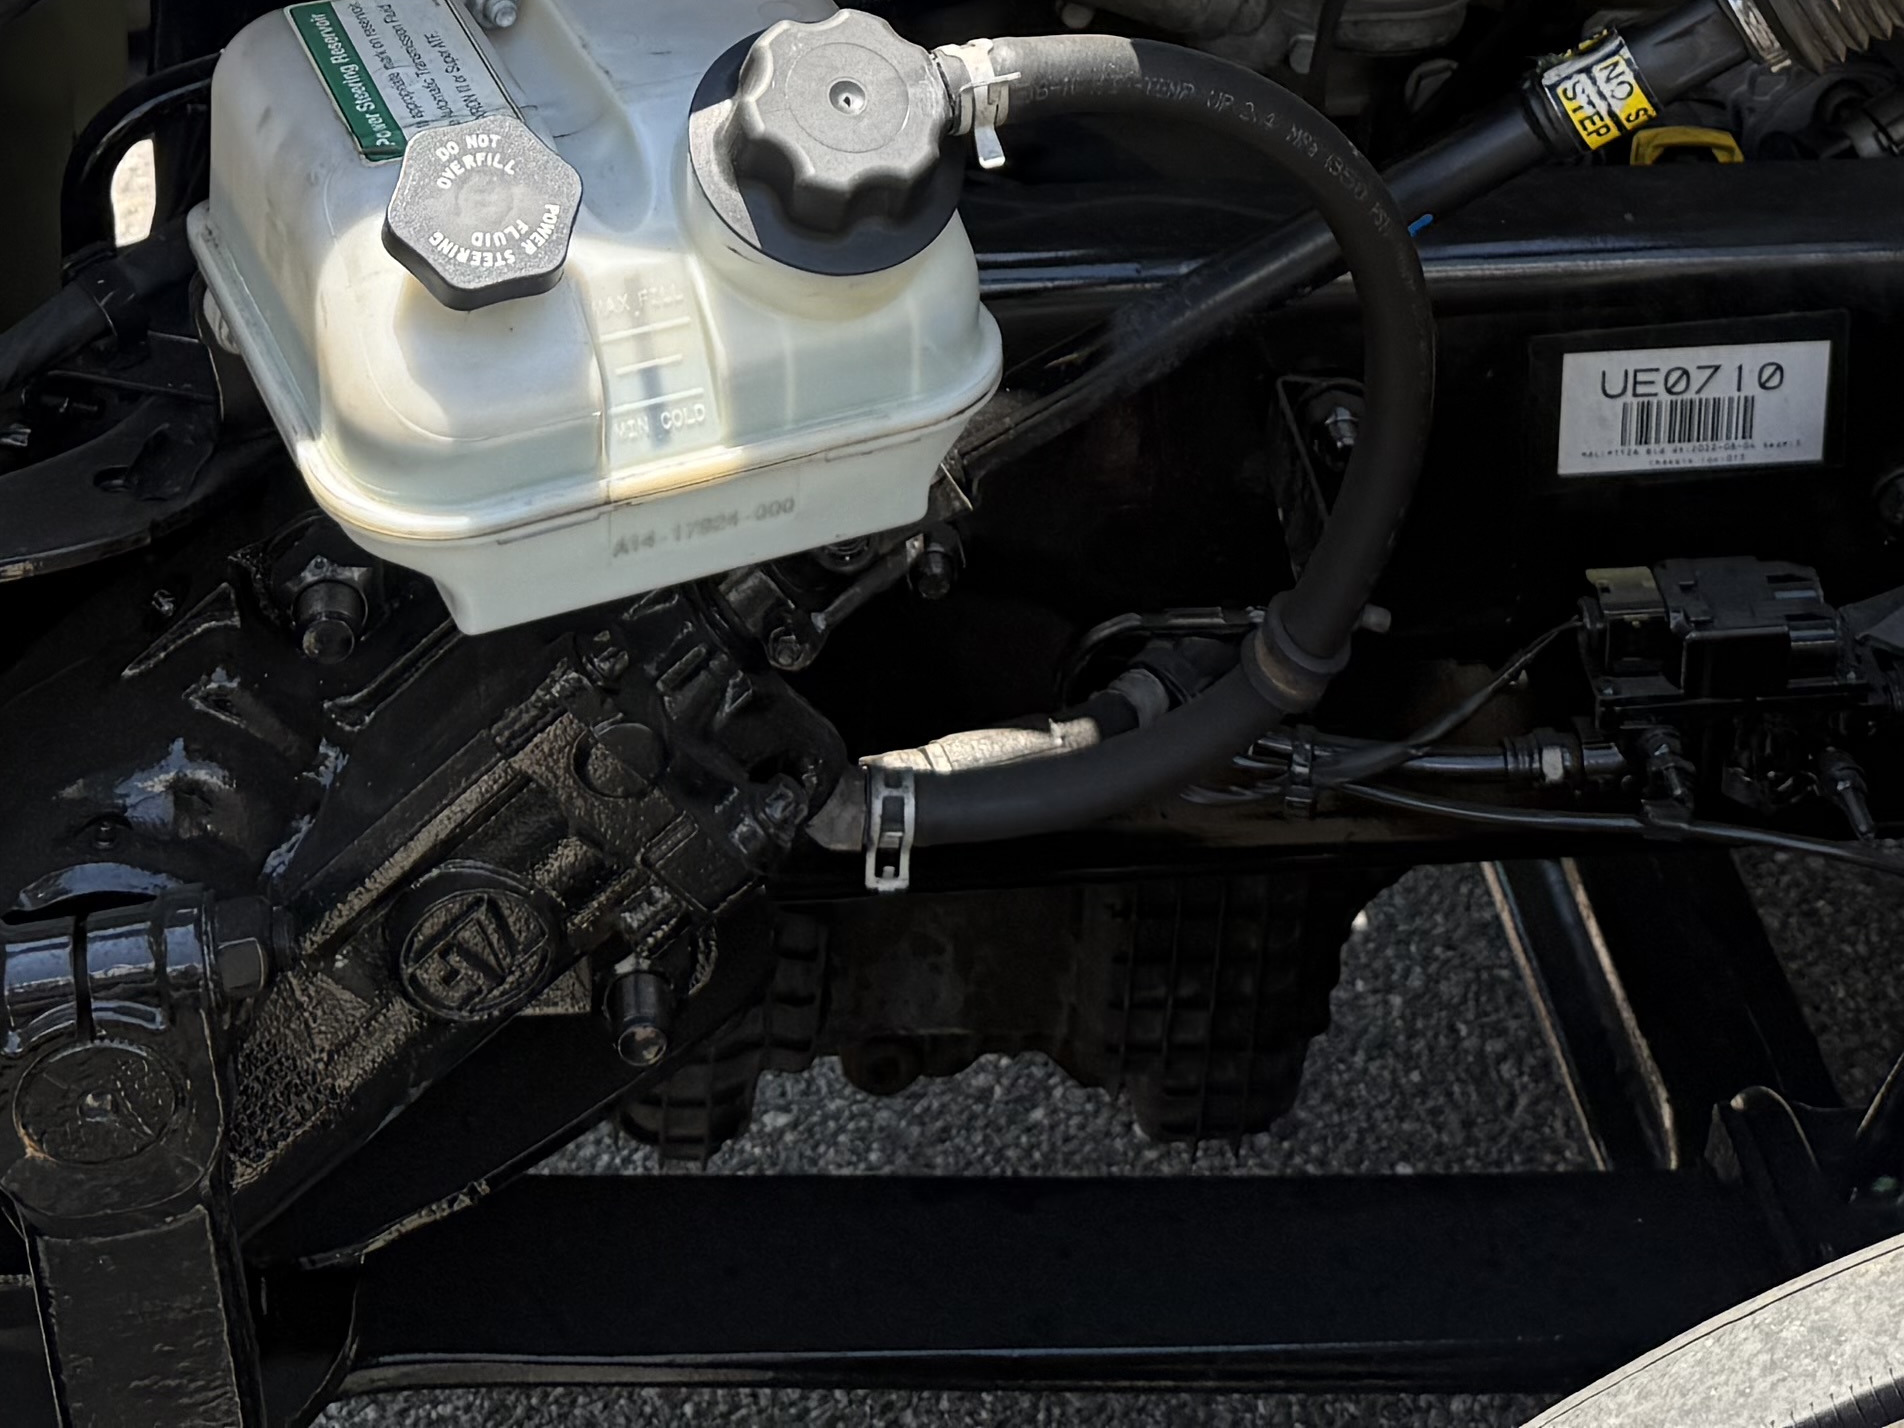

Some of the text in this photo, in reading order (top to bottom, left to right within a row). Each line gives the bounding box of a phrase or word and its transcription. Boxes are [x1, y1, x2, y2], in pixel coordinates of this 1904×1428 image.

[368, 37, 384, 52] on
[375, 52, 395, 71] mark
[376, 3, 454, 120] Automatic Transmission Fluid
[439, 46, 461, 75] Super
[311, 13, 395, 146] Power Steering Reservoir
[388, 72, 425, 119] appropriate
[1598, 59, 1635, 101] NO
[1561, 79, 1612, 138] STEP
[435, 134, 502, 163] DO NOT
[436, 152, 516, 190] OVERFILL
[428, 203, 560, 268] POWER STEERING
[471, 219, 529, 247] FLUID
[1601, 361, 1785, 399] UE0710
[615, 403, 706, 439] MIN COLD
